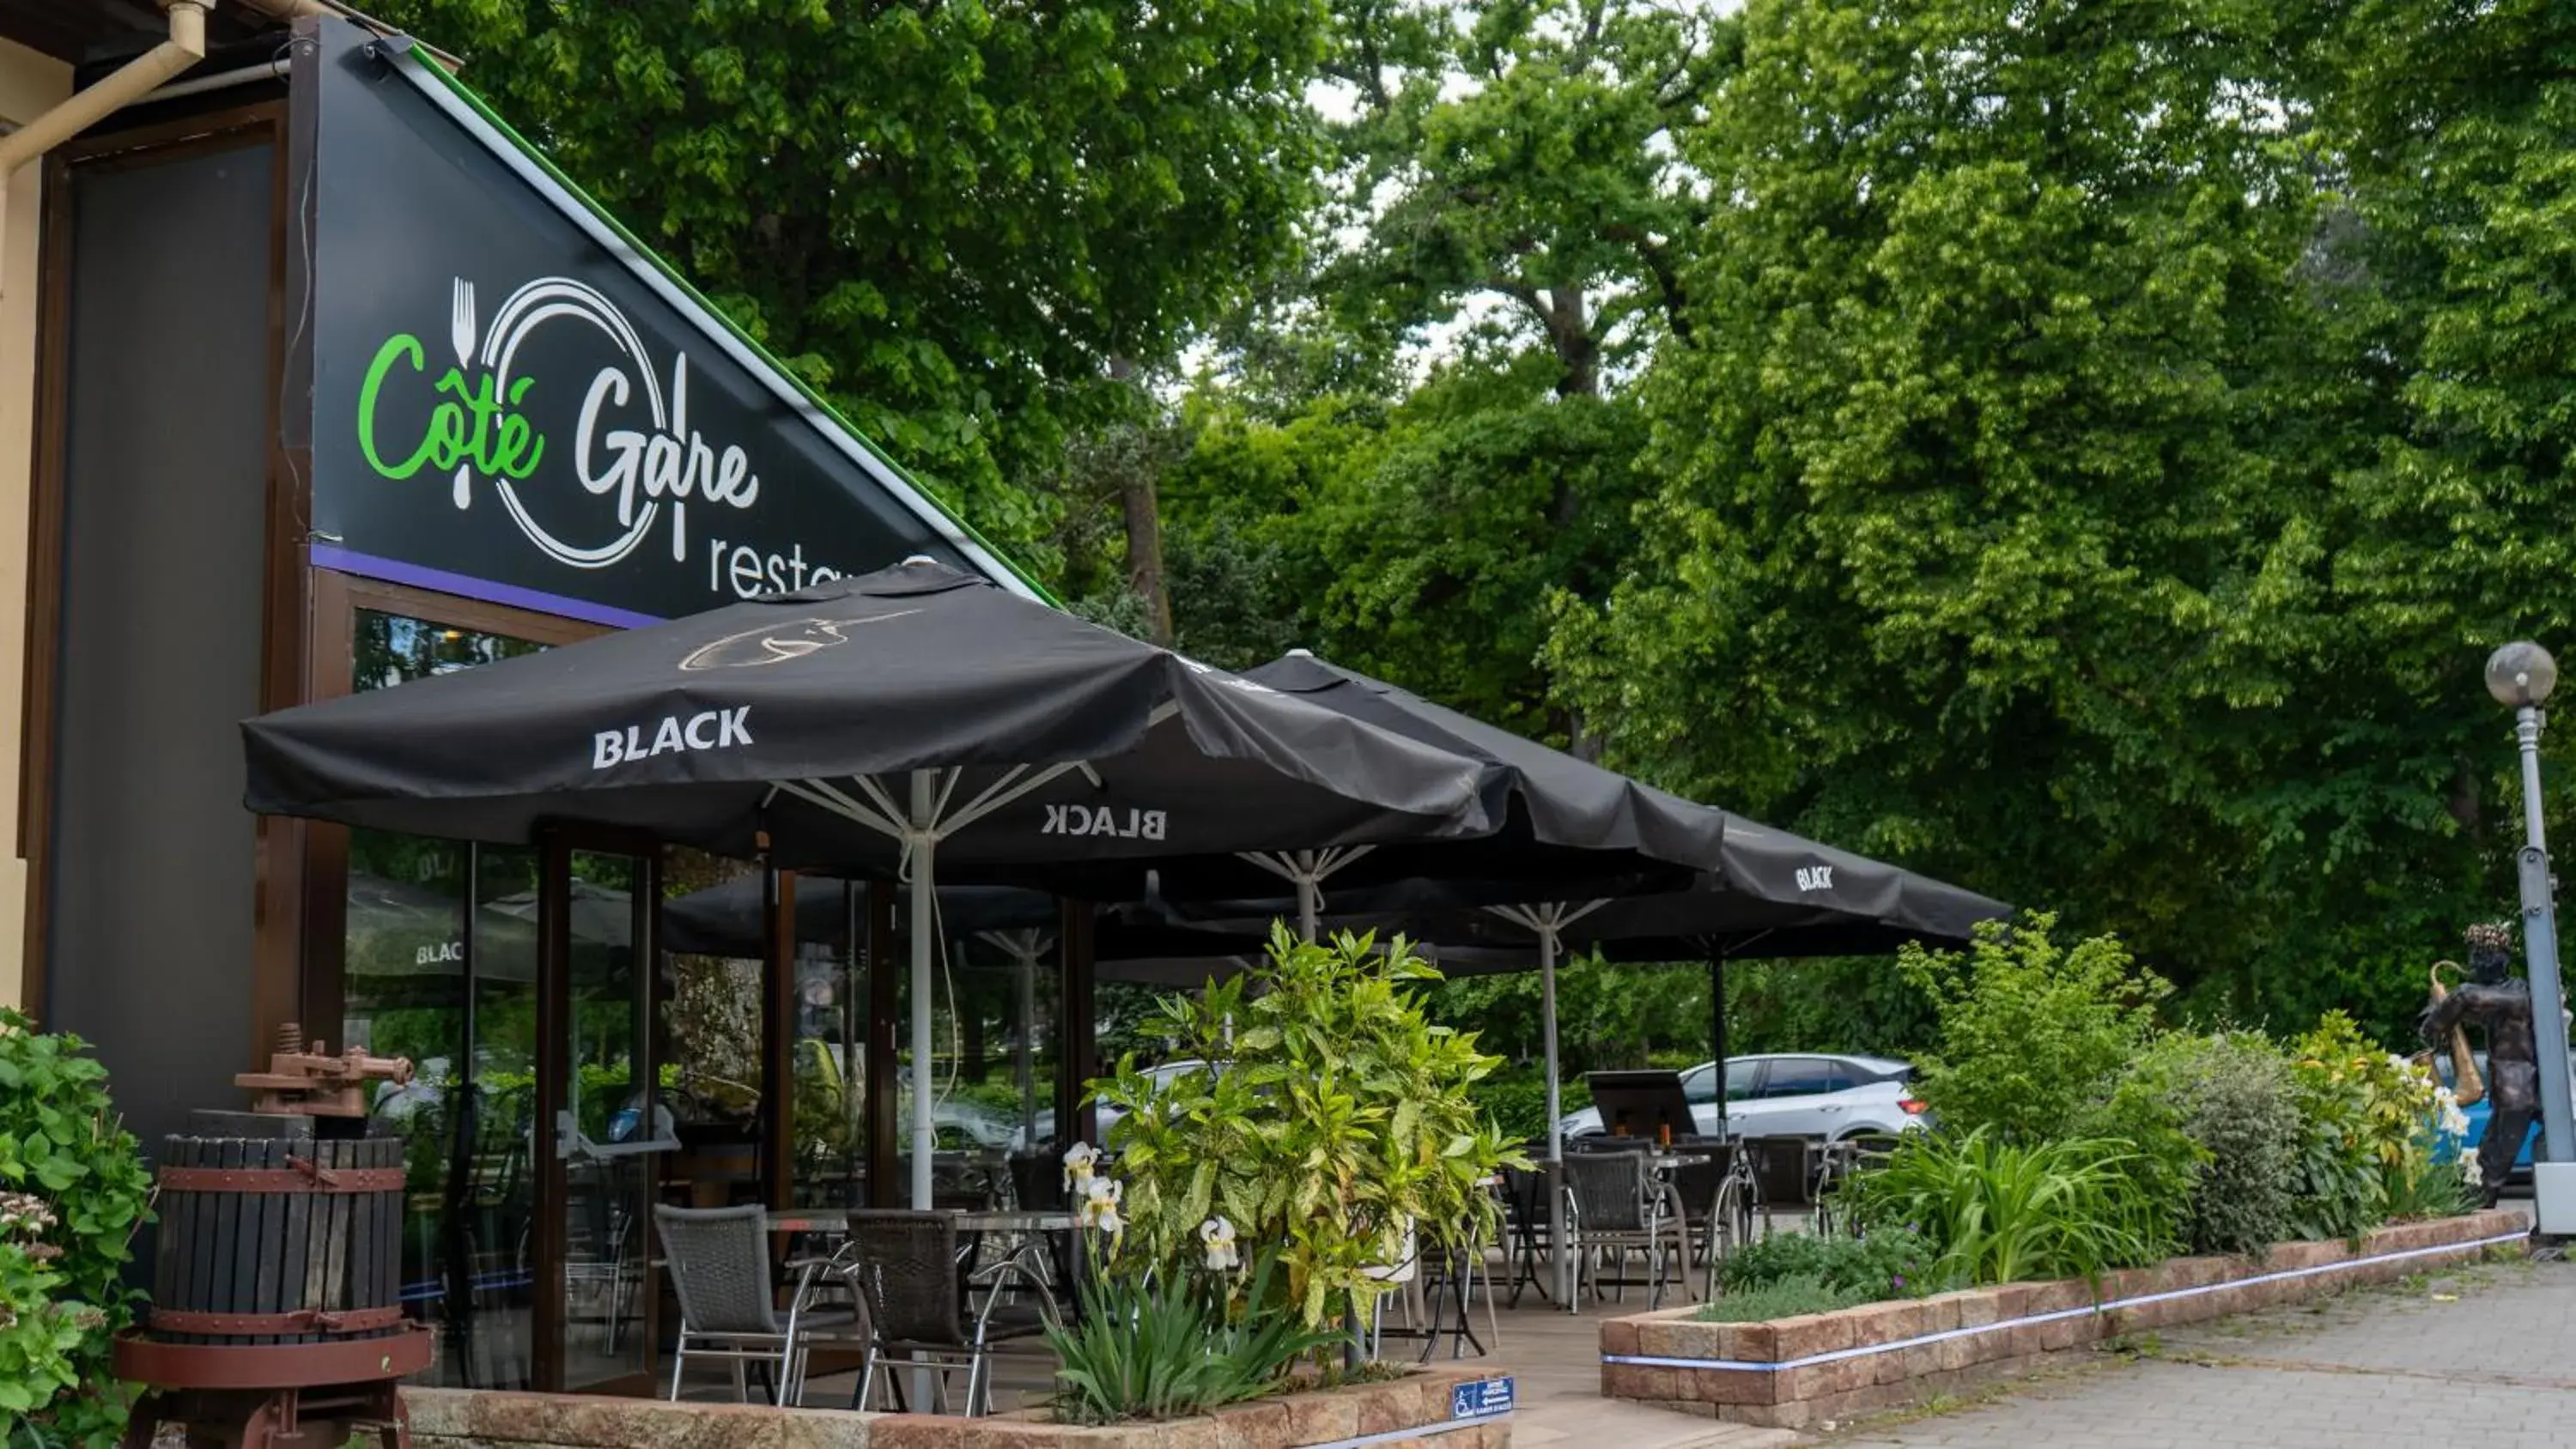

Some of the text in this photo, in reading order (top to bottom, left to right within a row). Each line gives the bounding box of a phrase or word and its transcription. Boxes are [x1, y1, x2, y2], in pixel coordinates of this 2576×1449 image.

[358, 333, 759, 525] Côté Gare
[592, 705, 754, 769] BLACK
